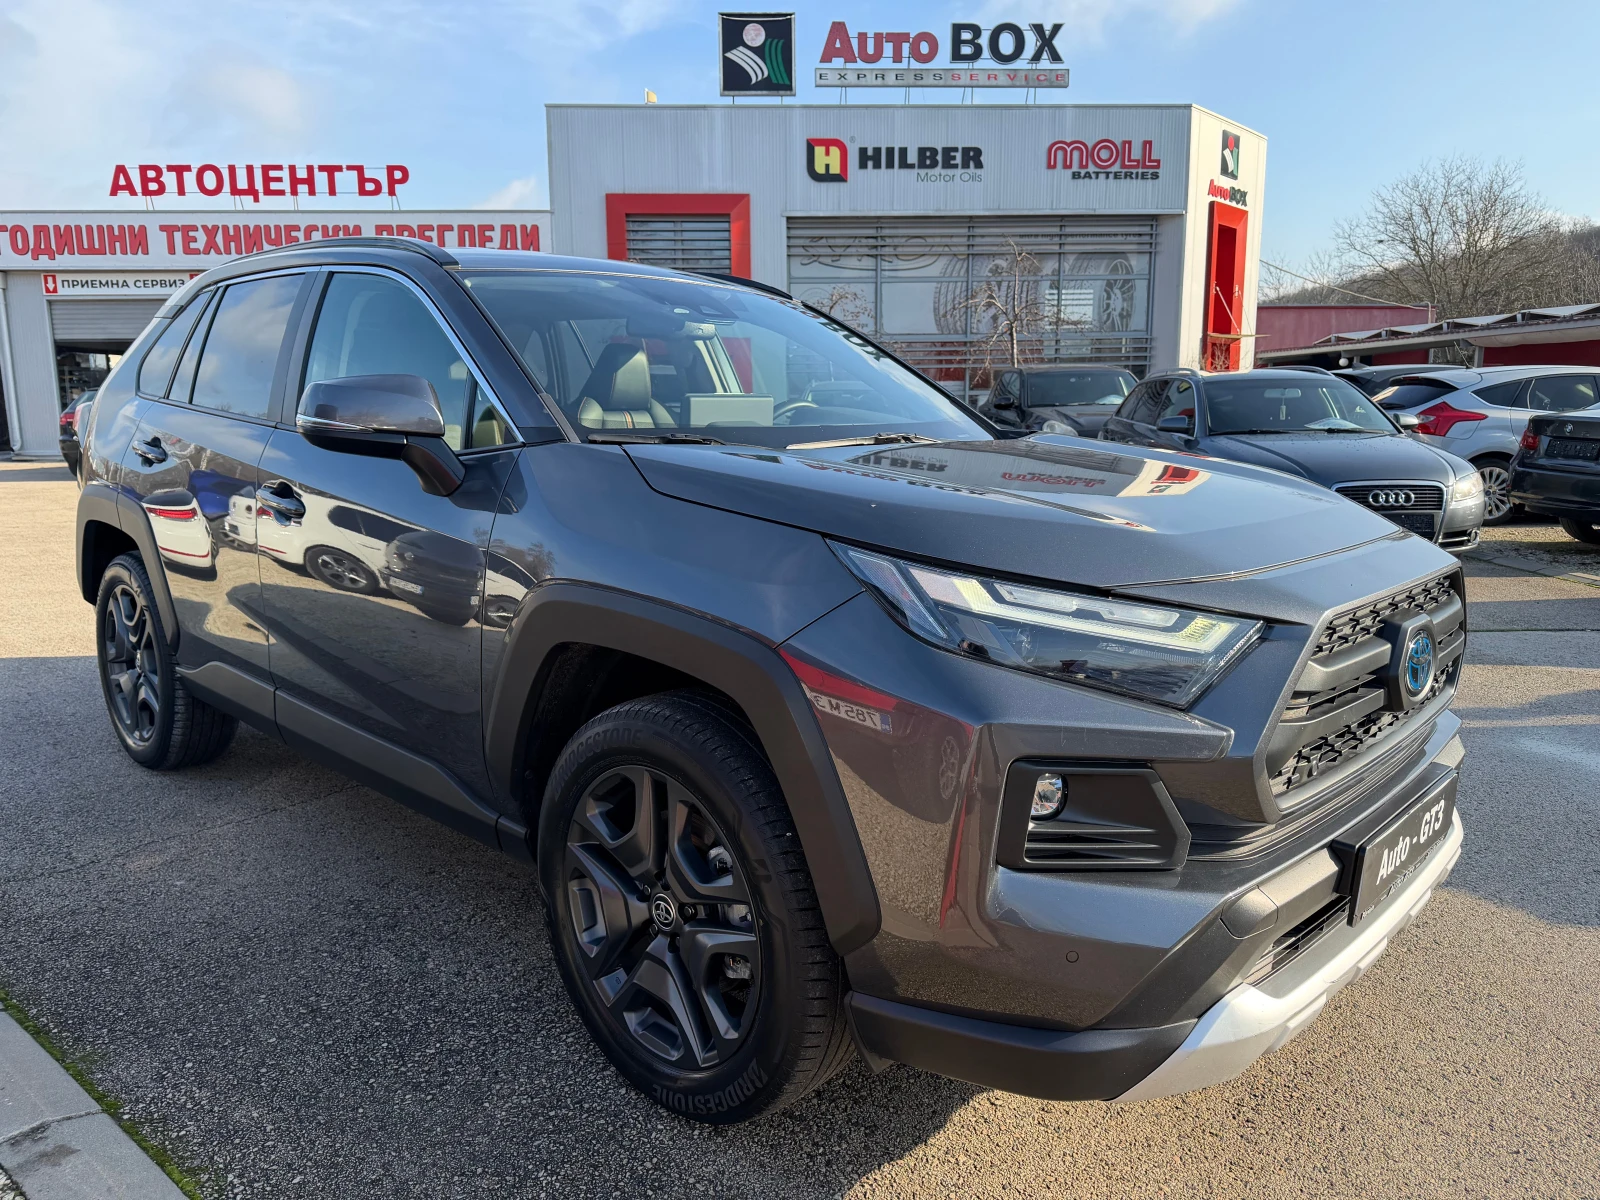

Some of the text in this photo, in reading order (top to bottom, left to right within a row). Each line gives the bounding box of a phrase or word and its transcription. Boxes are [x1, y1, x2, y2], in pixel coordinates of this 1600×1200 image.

[950, 22, 1065, 65] BOX
[858, 146, 985, 170] HILBER
[109, 164, 410, 203] АВТОЦЕНТЪР
[916, 172, 983, 183] Motor Oils
[1071, 171, 1160, 180] BATTERIES
[61, 279, 186, 289] ПРИЕМНА СЕРВИЗ
[1376, 836, 1410, 886] Auto
[1420, 799, 1445, 844] GT3
